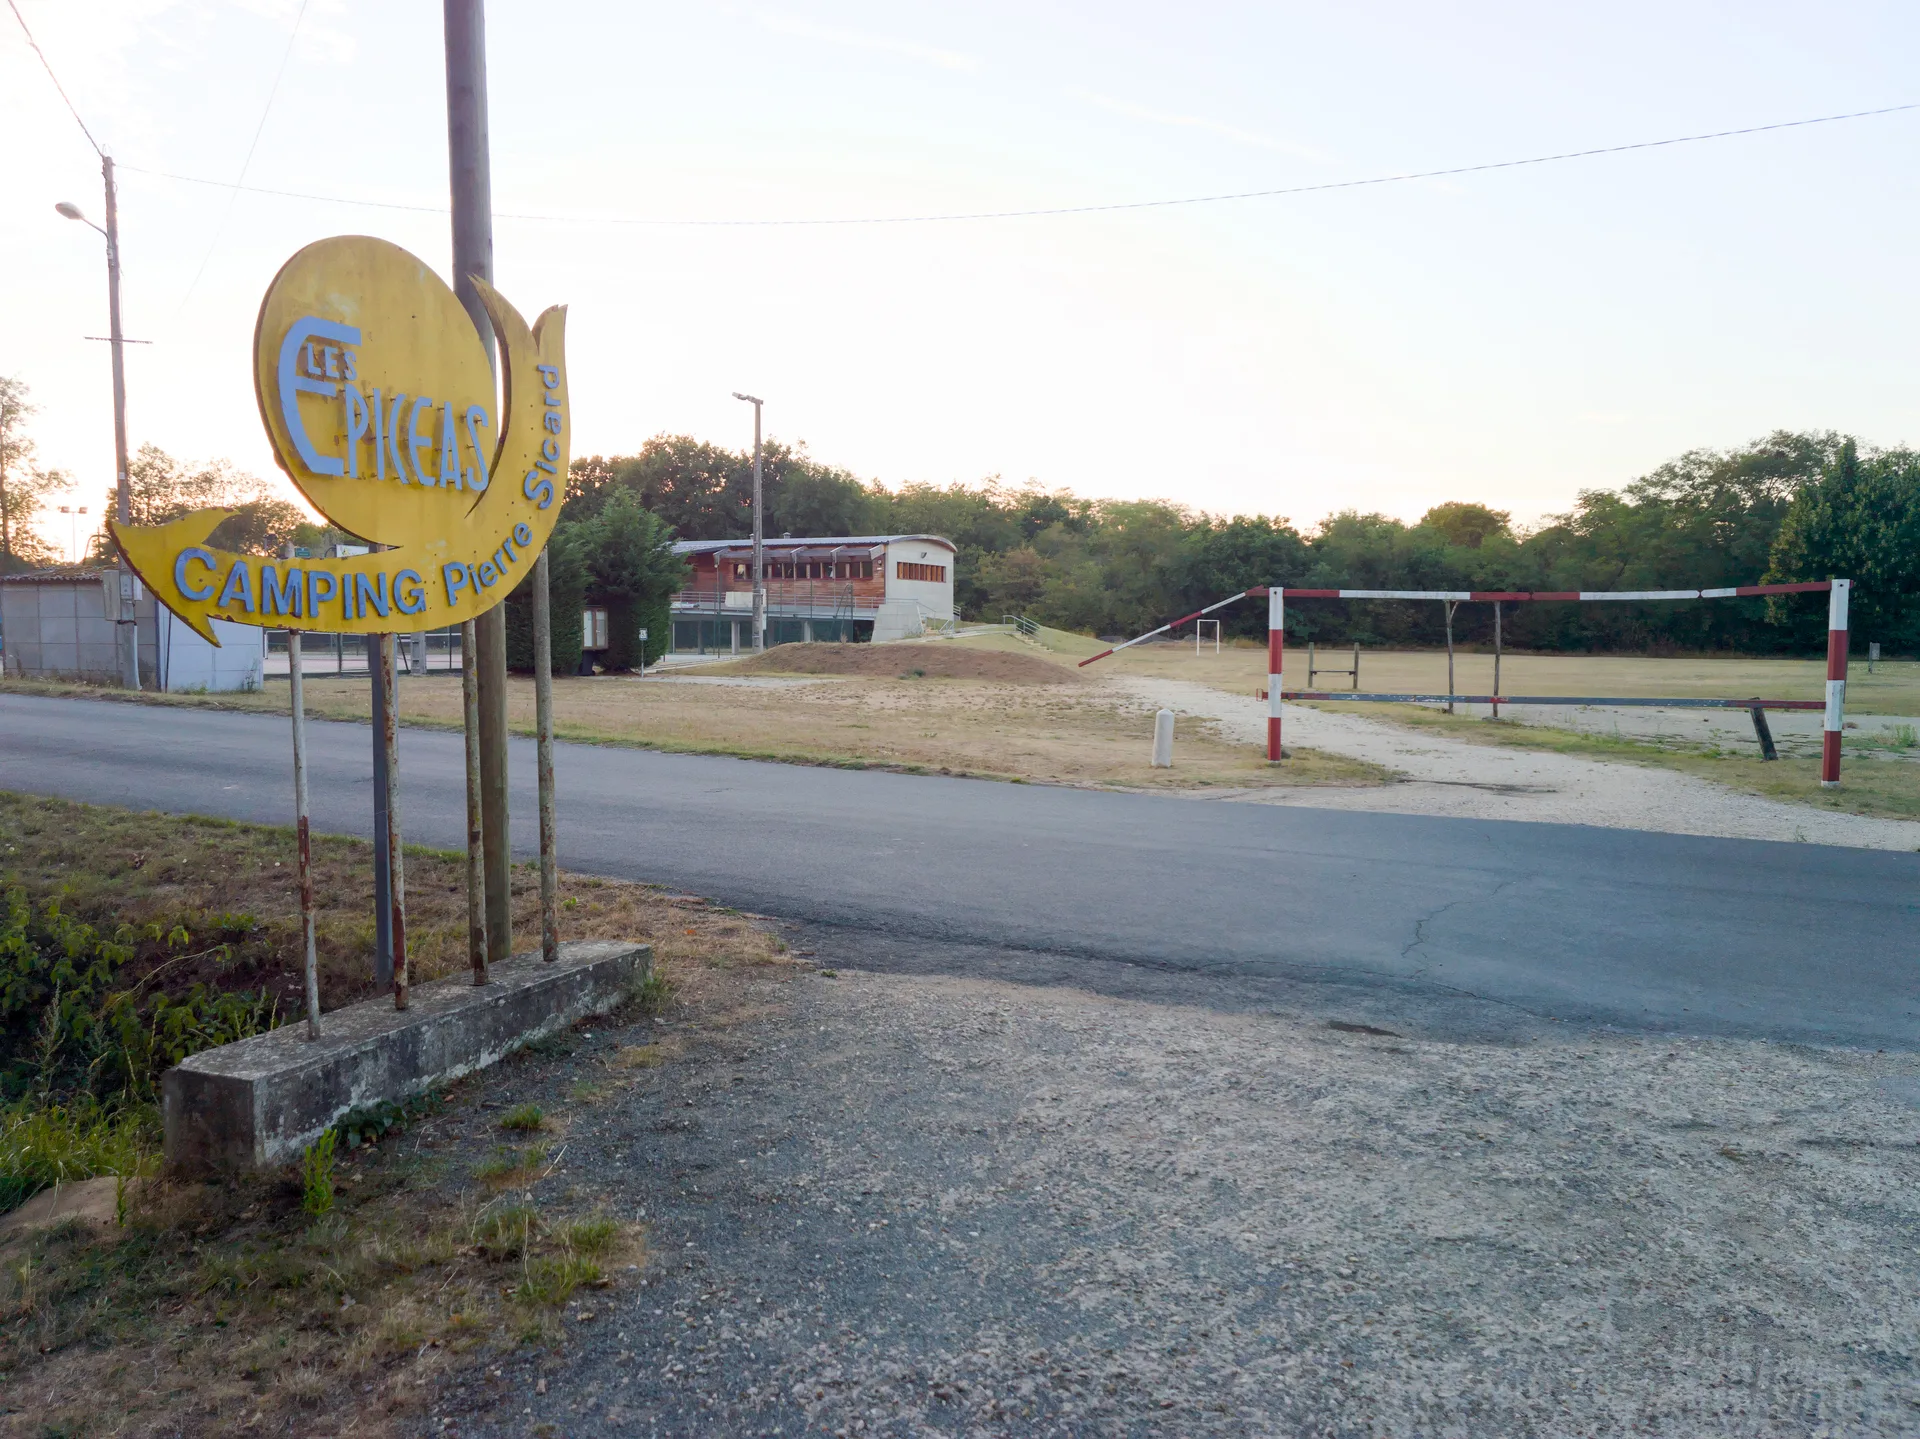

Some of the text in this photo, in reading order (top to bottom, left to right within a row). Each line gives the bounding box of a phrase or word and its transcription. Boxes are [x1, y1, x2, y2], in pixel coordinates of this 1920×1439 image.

[307, 342, 358, 381] LES
[174, 364, 562, 620] CAMPING Pierre Sicard
